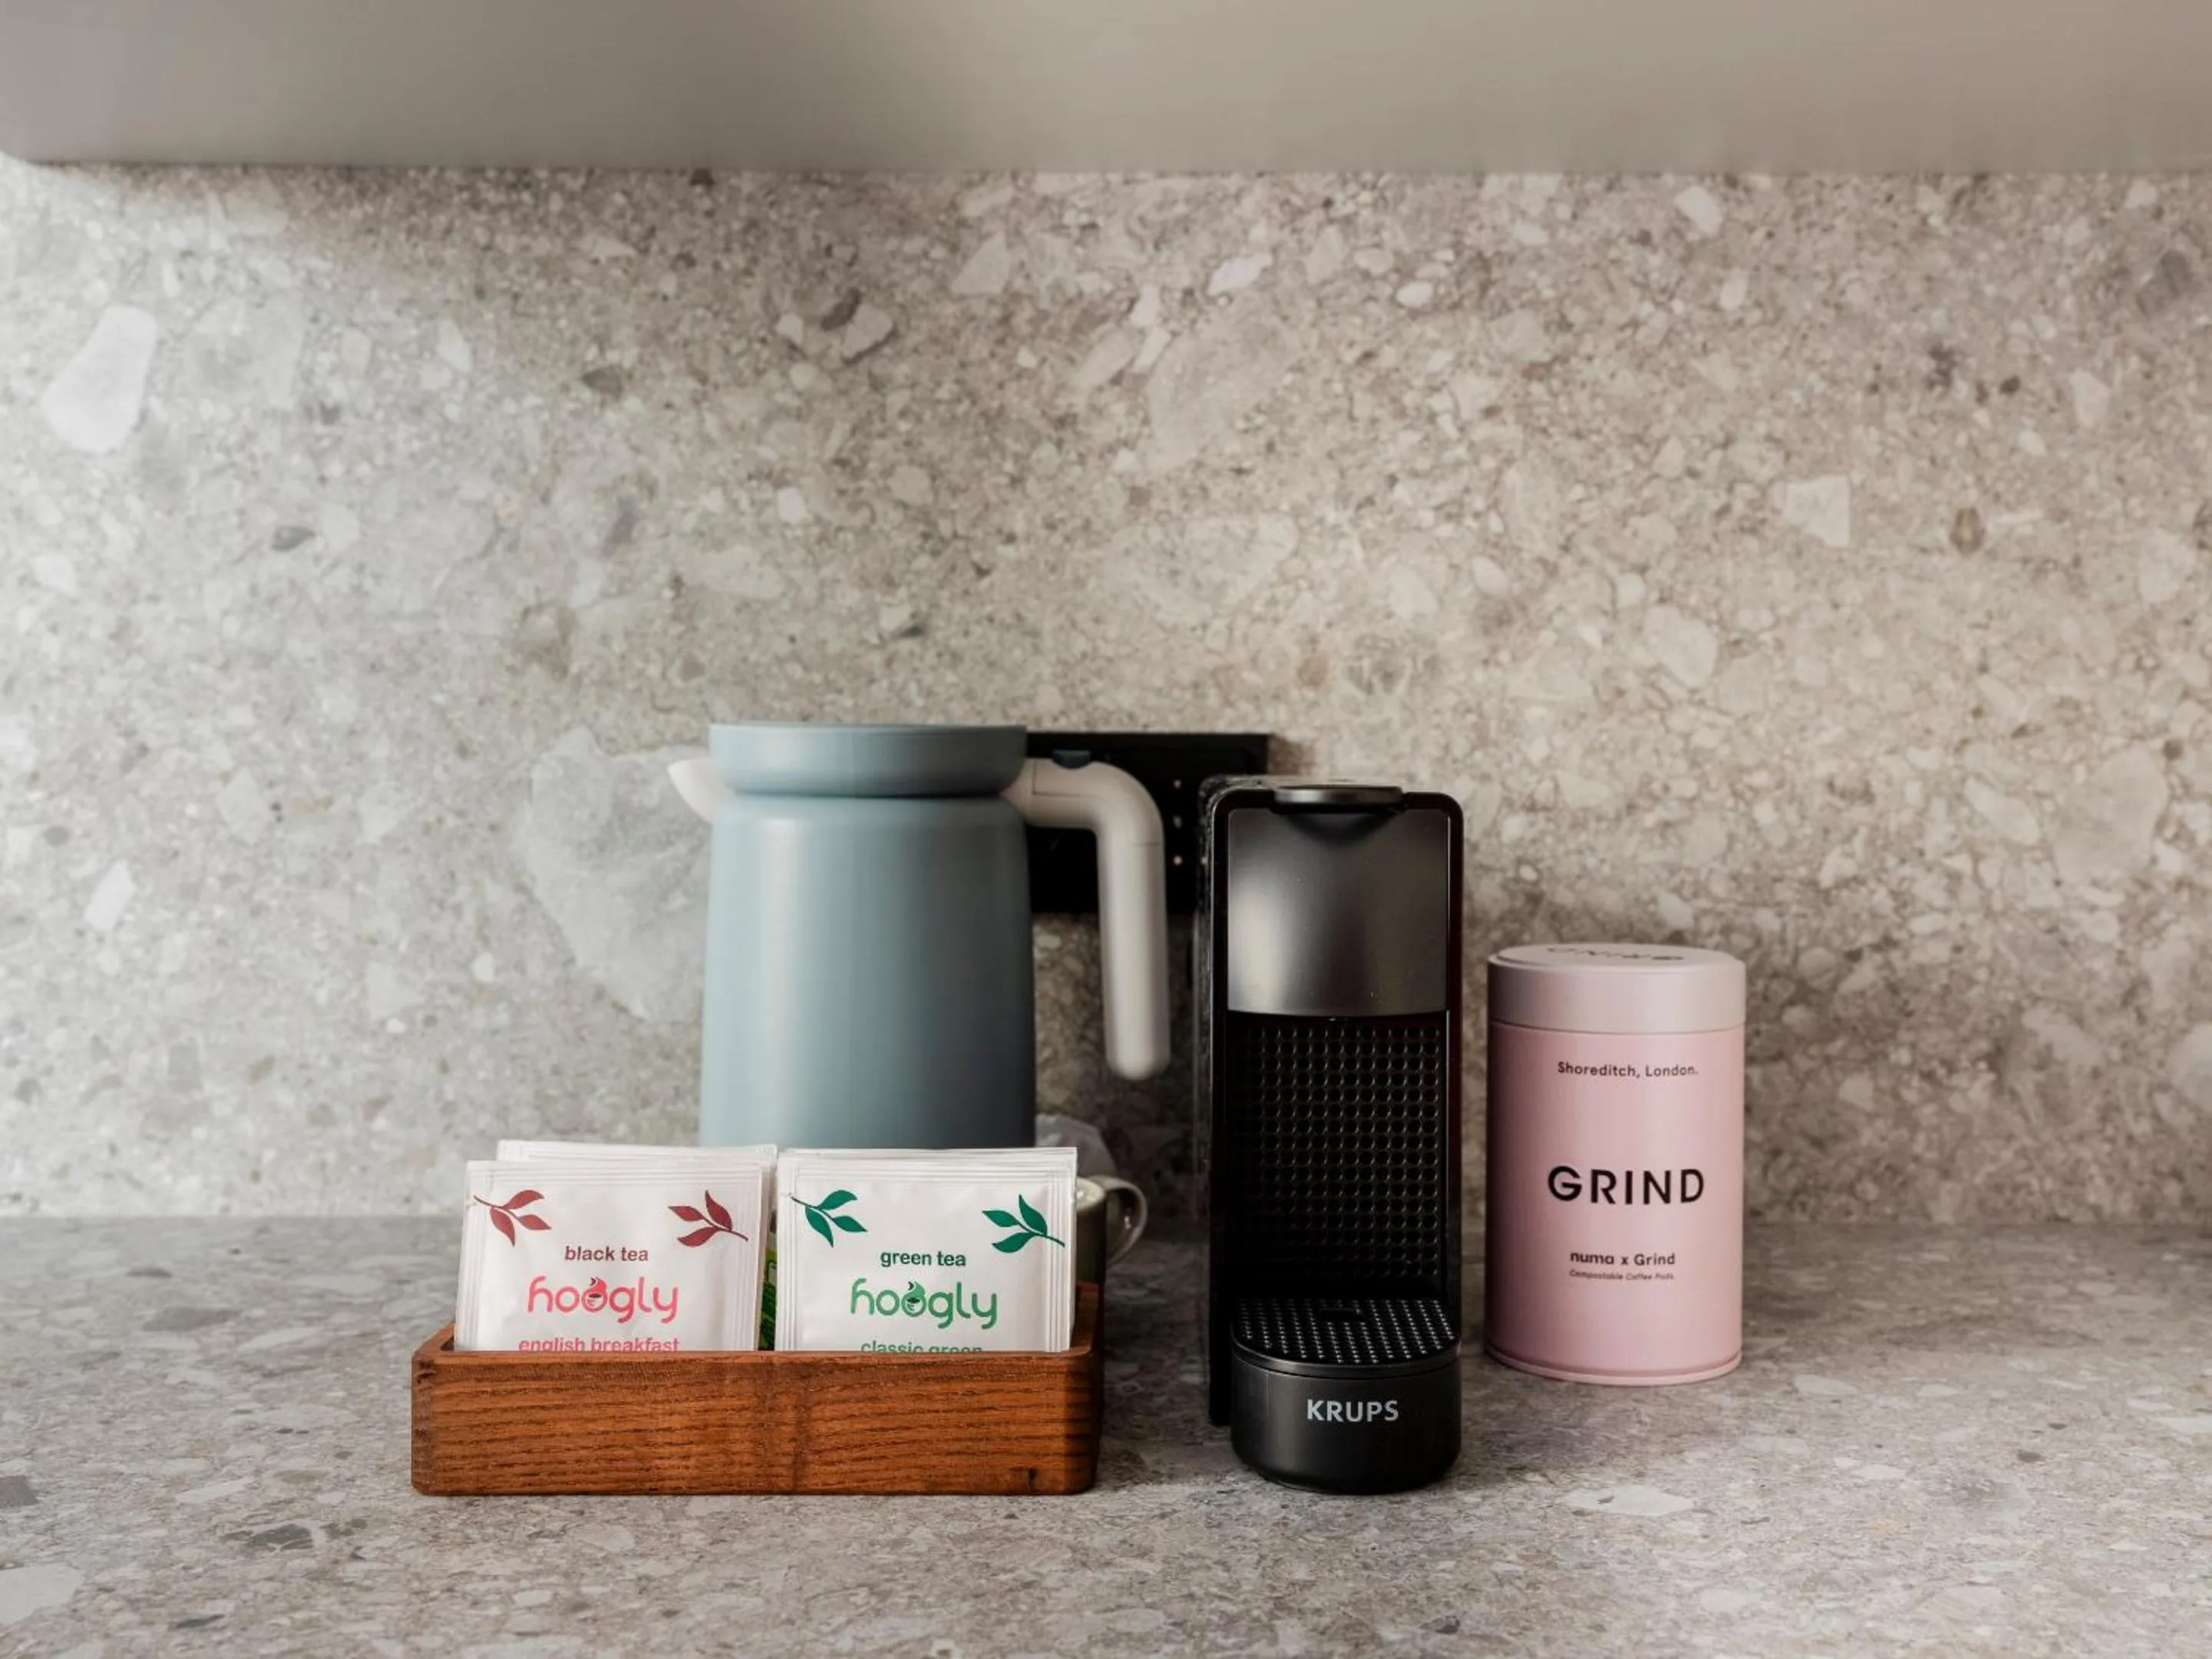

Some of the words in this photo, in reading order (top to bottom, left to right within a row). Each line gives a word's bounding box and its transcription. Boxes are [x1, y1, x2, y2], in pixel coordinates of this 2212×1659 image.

[1558, 1061, 1641, 1078] Shoreditch,
[1645, 1065, 1698, 1077] London.
[1548, 1166, 1704, 1205] GRIND
[565, 1246, 615, 1261] black
[621, 1247, 649, 1262] tea
[880, 1251, 932, 1267] green
[937, 1251, 966, 1267] tea
[1570, 1253, 1614, 1265] numa
[1621, 1257, 1628, 1265] x
[1634, 1253, 1675, 1266] Grind
[528, 1276, 678, 1323] hoogly
[850, 1277, 998, 1330] hoogly
[518, 1337, 585, 1352] english
[591, 1337, 680, 1352] breakfast
[861, 1339, 923, 1353] classic
[1307, 1399, 1399, 1422] KRUPS
